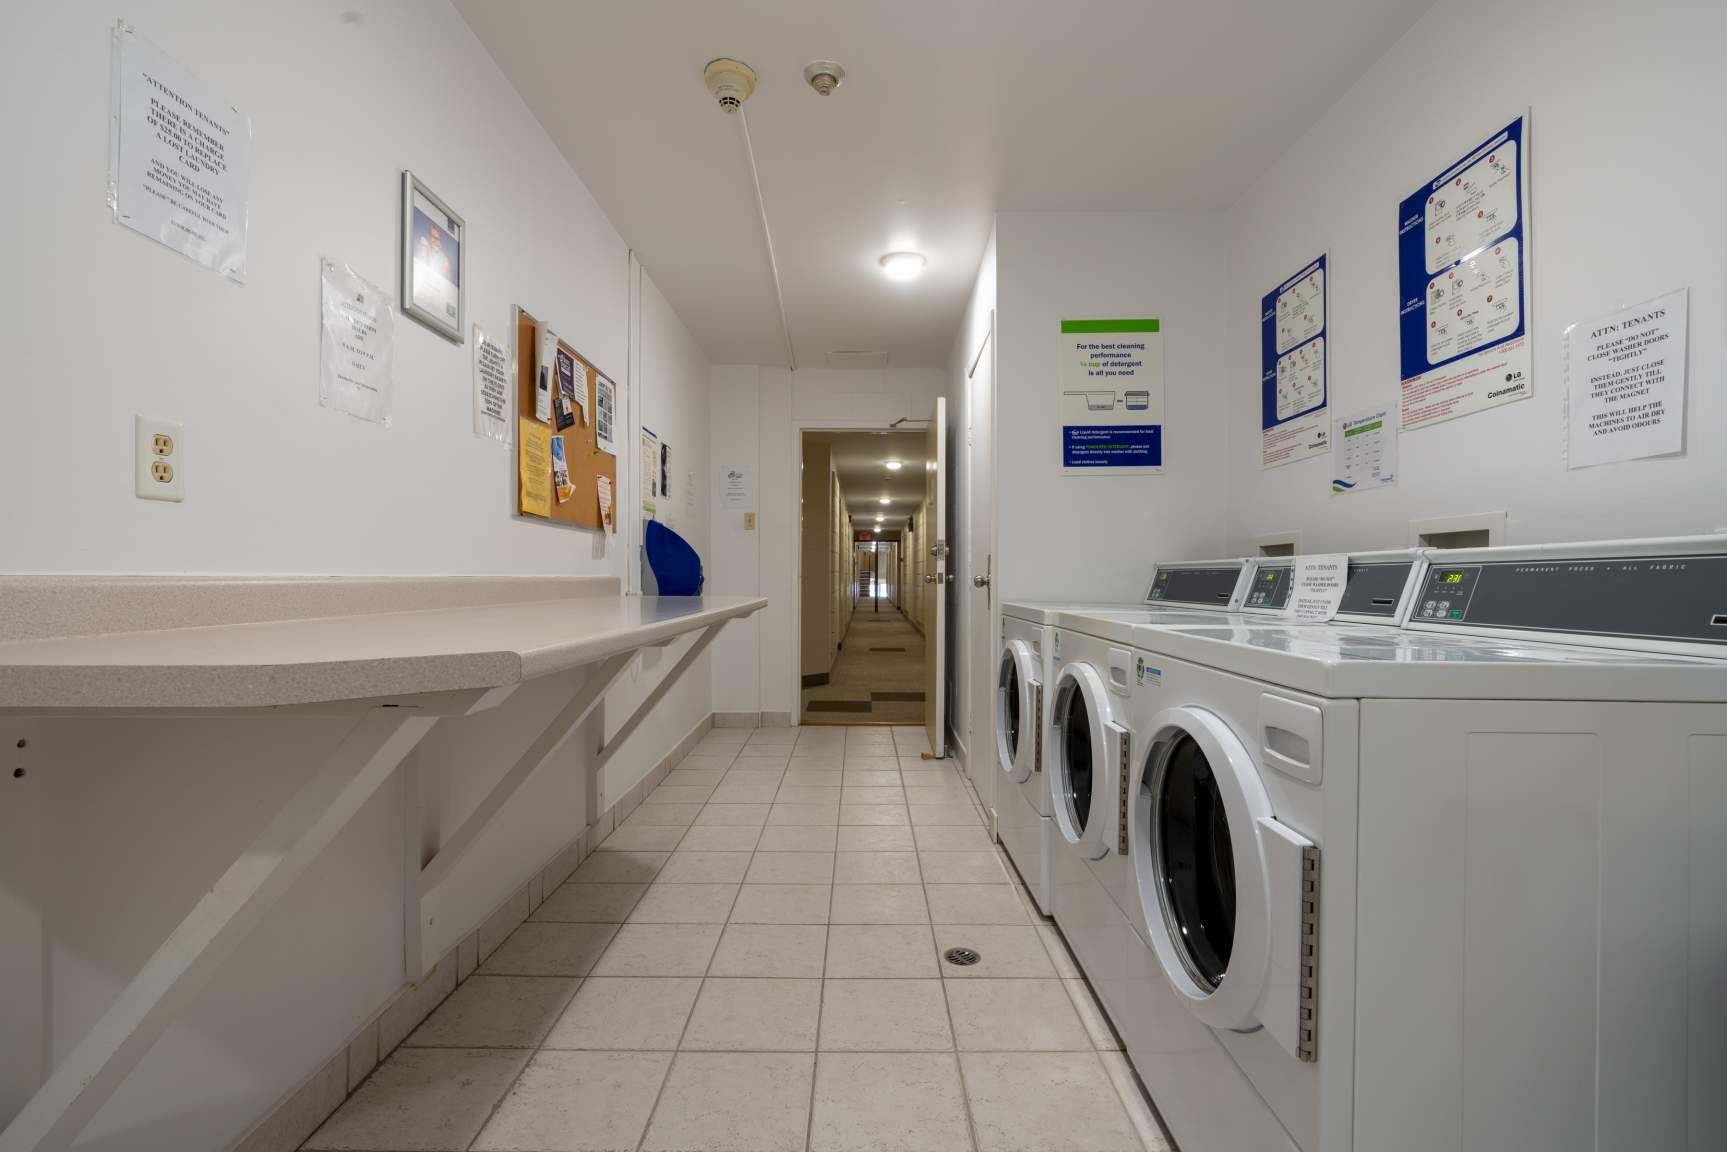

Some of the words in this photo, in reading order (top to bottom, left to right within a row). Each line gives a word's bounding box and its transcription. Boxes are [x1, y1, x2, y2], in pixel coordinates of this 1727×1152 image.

[151, 98, 181, 121] PLEASE
[183, 119, 224, 151] REMEMBER
[151, 107, 177, 129] THERE
[180, 126, 186, 136] IS
[194, 137, 224, 160] CHARGE
[147, 116, 157, 126] OF
[183, 139, 193, 149] TO
[195, 147, 226, 171] REPLACE
[163, 136, 184, 153] LOST
[185, 150, 219, 175] LAUNDRY
[179, 155, 200, 172] CARD
[1590, 324, 1619, 339] ATTN:
[1622, 309, 1666, 330] TENANTS
[1587, 350, 1611, 362] CLOSE
[1612, 342, 1642, 355] WASHER
[1644, 334, 1669, 346] DOORS
[1597, 339, 1624, 351] PLEASE
[1513, 371, 1522, 380] LG
[1623, 366, 1640, 376] JUST
[1641, 359, 1665, 371] CLOSE
[1591, 389, 1609, 398] THEY
[1610, 382, 1644, 396] CONNECT
[1645, 375, 1665, 386] WITH
[1594, 381, 1614, 390] THEM
[1615, 373, 1643, 386] GENTLY
[1645, 368, 1662, 379] TILL
[1487, 383, 1525, 400] Coinamatic
[1604, 395, 1618, 403] THE
[1619, 388, 1649, 401] MAGNET
[1589, 418, 1625, 430] MACHINES
[1637, 413, 1650, 422] AIR
[1651, 409, 1666, 418] DRY
[1592, 412, 1608, 421] THIS
[1609, 408, 1628, 418] WILL
[1628, 405, 1647, 414] HELP
[1648, 401, 1662, 410] THE
[1592, 428, 1608, 436] AND
[1608, 423, 1631, 433] AVOID
[1632, 419, 1661, 430] ODOURS
